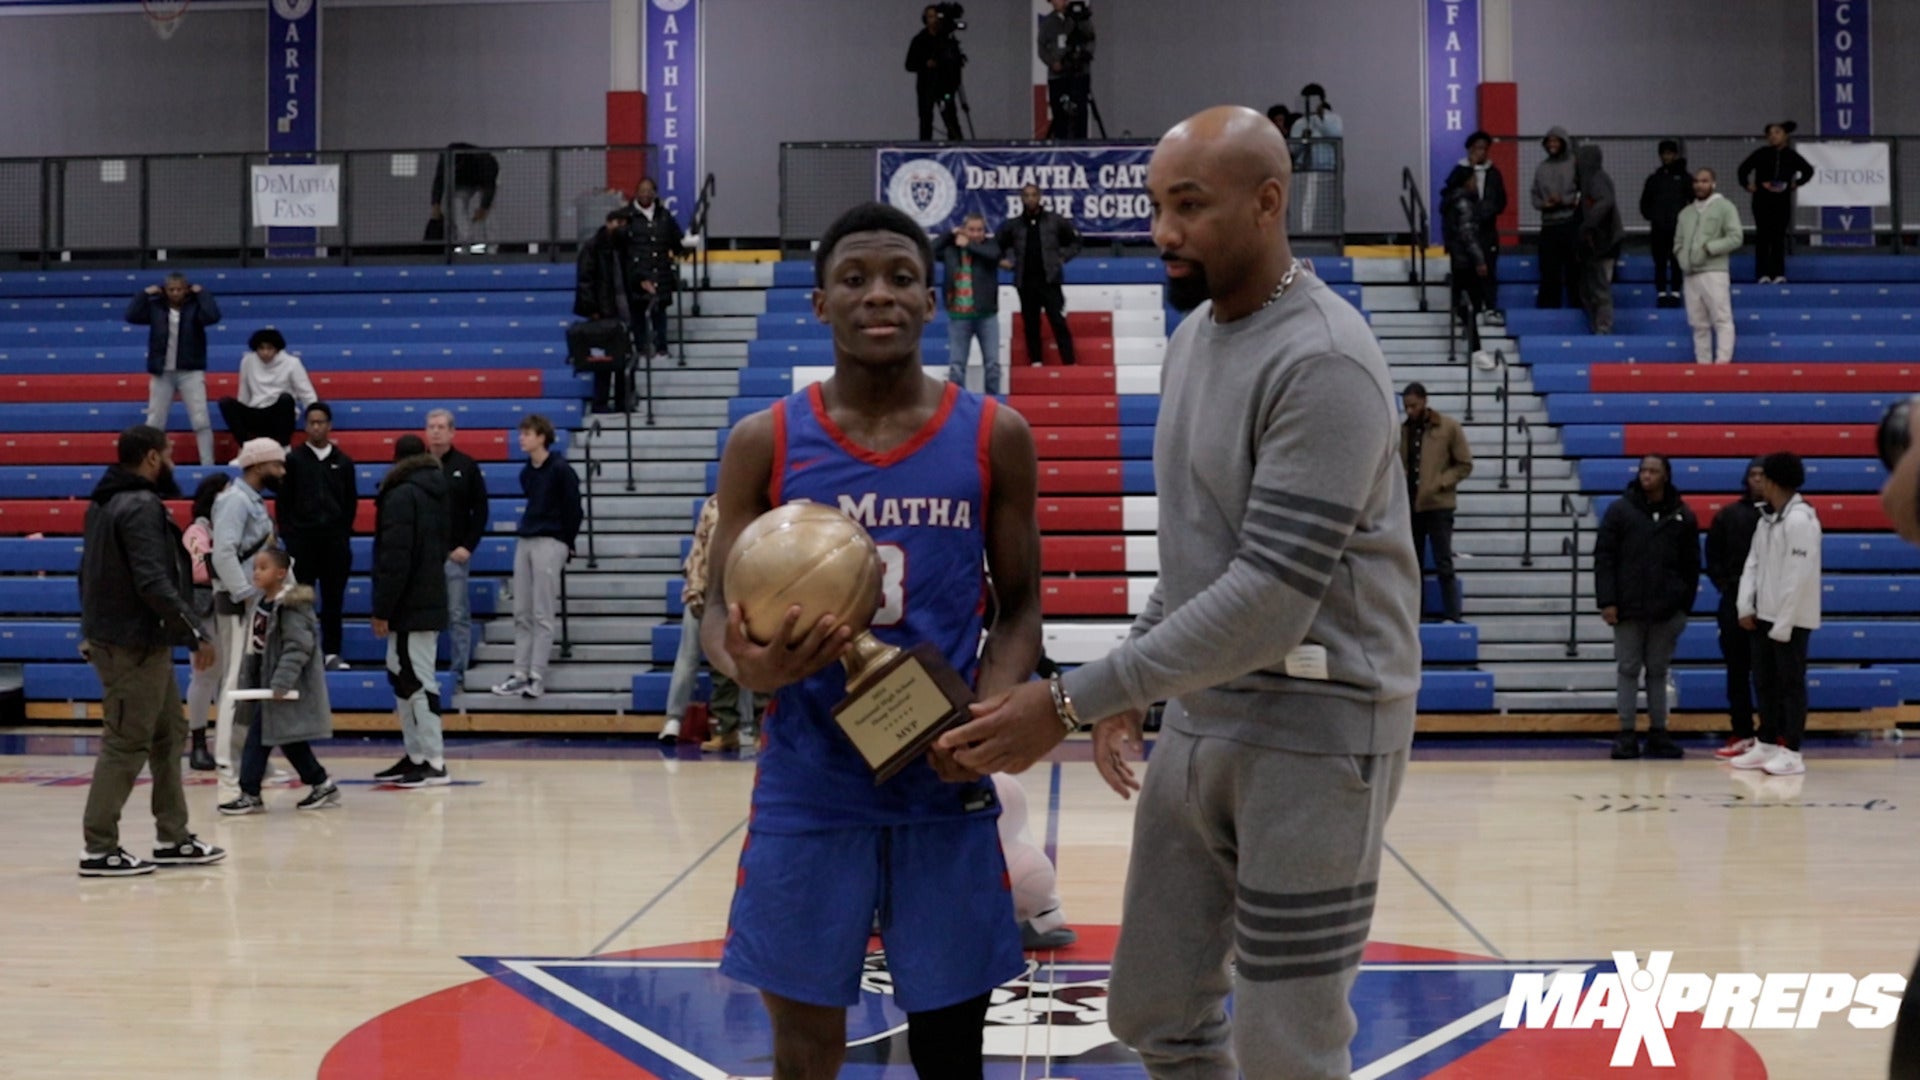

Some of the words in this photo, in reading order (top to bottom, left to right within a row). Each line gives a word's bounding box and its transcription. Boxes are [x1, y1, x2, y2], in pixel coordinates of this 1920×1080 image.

[284, 22, 300, 120] ARTS
[1445, 4, 1462, 131] FAITH
[966, 165, 1089, 190] DEMATHA
[1099, 164, 1150, 188] CAT
[1818, 168, 1886, 185] ISITORS
[273, 199, 316, 218] FANS
[1006, 195, 1073, 219] HGH
[1083, 194, 1153, 219] SCHO
[895, 719, 919, 740] MVP
